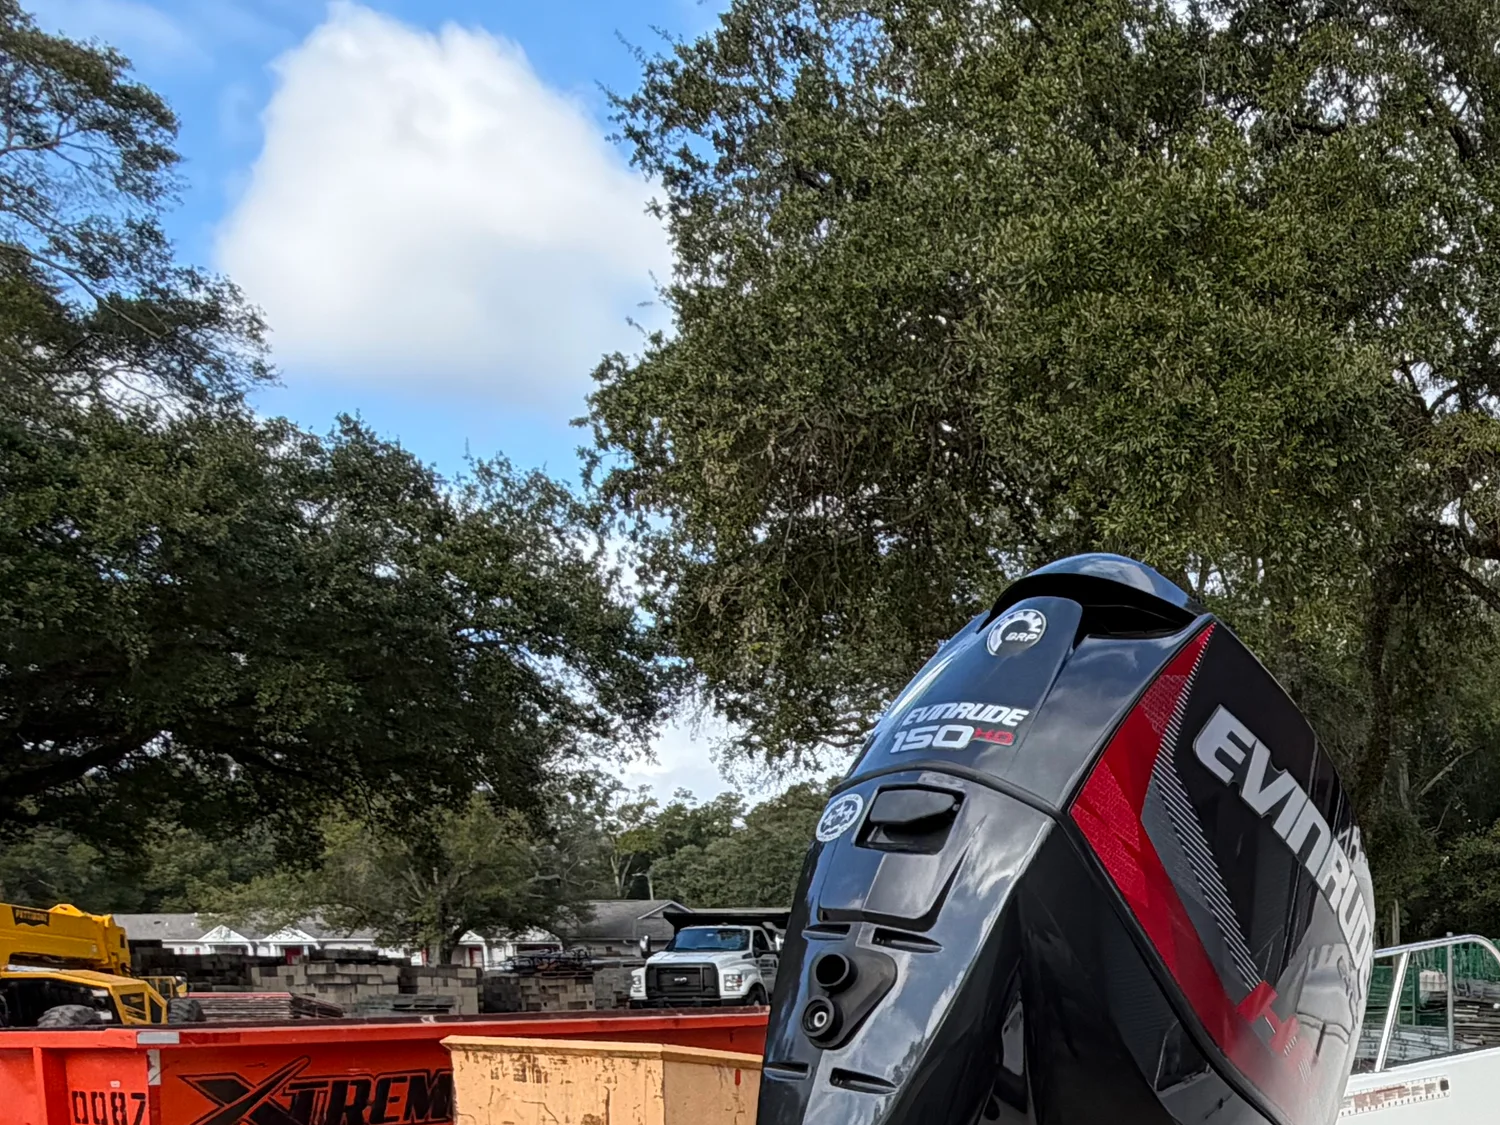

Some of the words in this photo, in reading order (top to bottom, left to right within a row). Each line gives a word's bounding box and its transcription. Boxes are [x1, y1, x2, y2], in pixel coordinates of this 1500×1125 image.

[1005, 632, 1038, 642] BRP
[902, 702, 1029, 727] EVINRUDE
[890, 724, 975, 753] 150
[1193, 704, 1371, 990] EVINRUD
